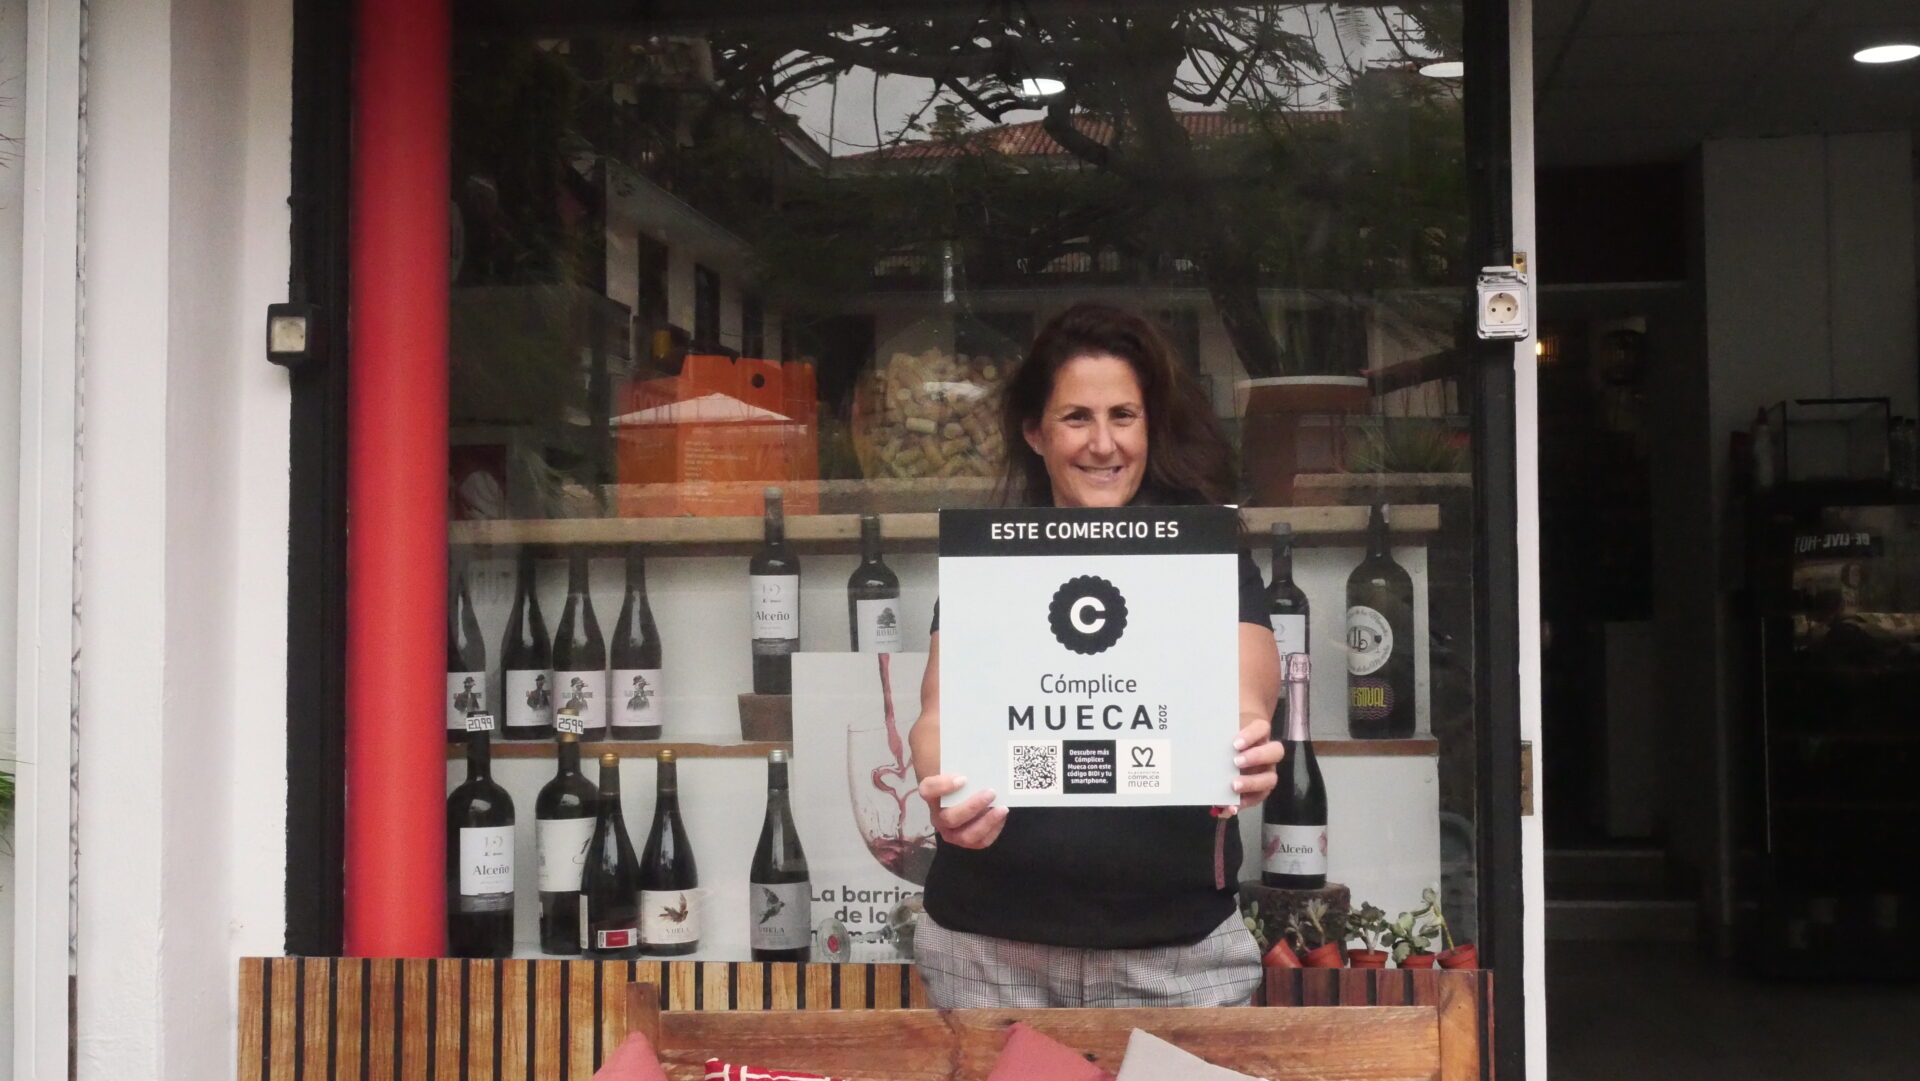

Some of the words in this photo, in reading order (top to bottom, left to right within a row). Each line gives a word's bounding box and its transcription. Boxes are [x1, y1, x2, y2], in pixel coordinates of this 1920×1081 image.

[991, 522, 1039, 540] ESTE
[1045, 521, 1148, 539] COMERCIO
[1155, 521, 1179, 538] ES
[1070, 596, 1106, 634] C
[1040, 673, 1137, 699] Cómplice
[1008, 704, 1154, 730] MUECA
[1158, 704, 1168, 730] 2026
[1097, 748, 1109, 756] más
[1128, 780, 1160, 788] mueca
[1278, 843, 1313, 854] Alceño
[473, 864, 510, 876] Alceño
[810, 884, 835, 902] La
[834, 906, 862, 923] de
